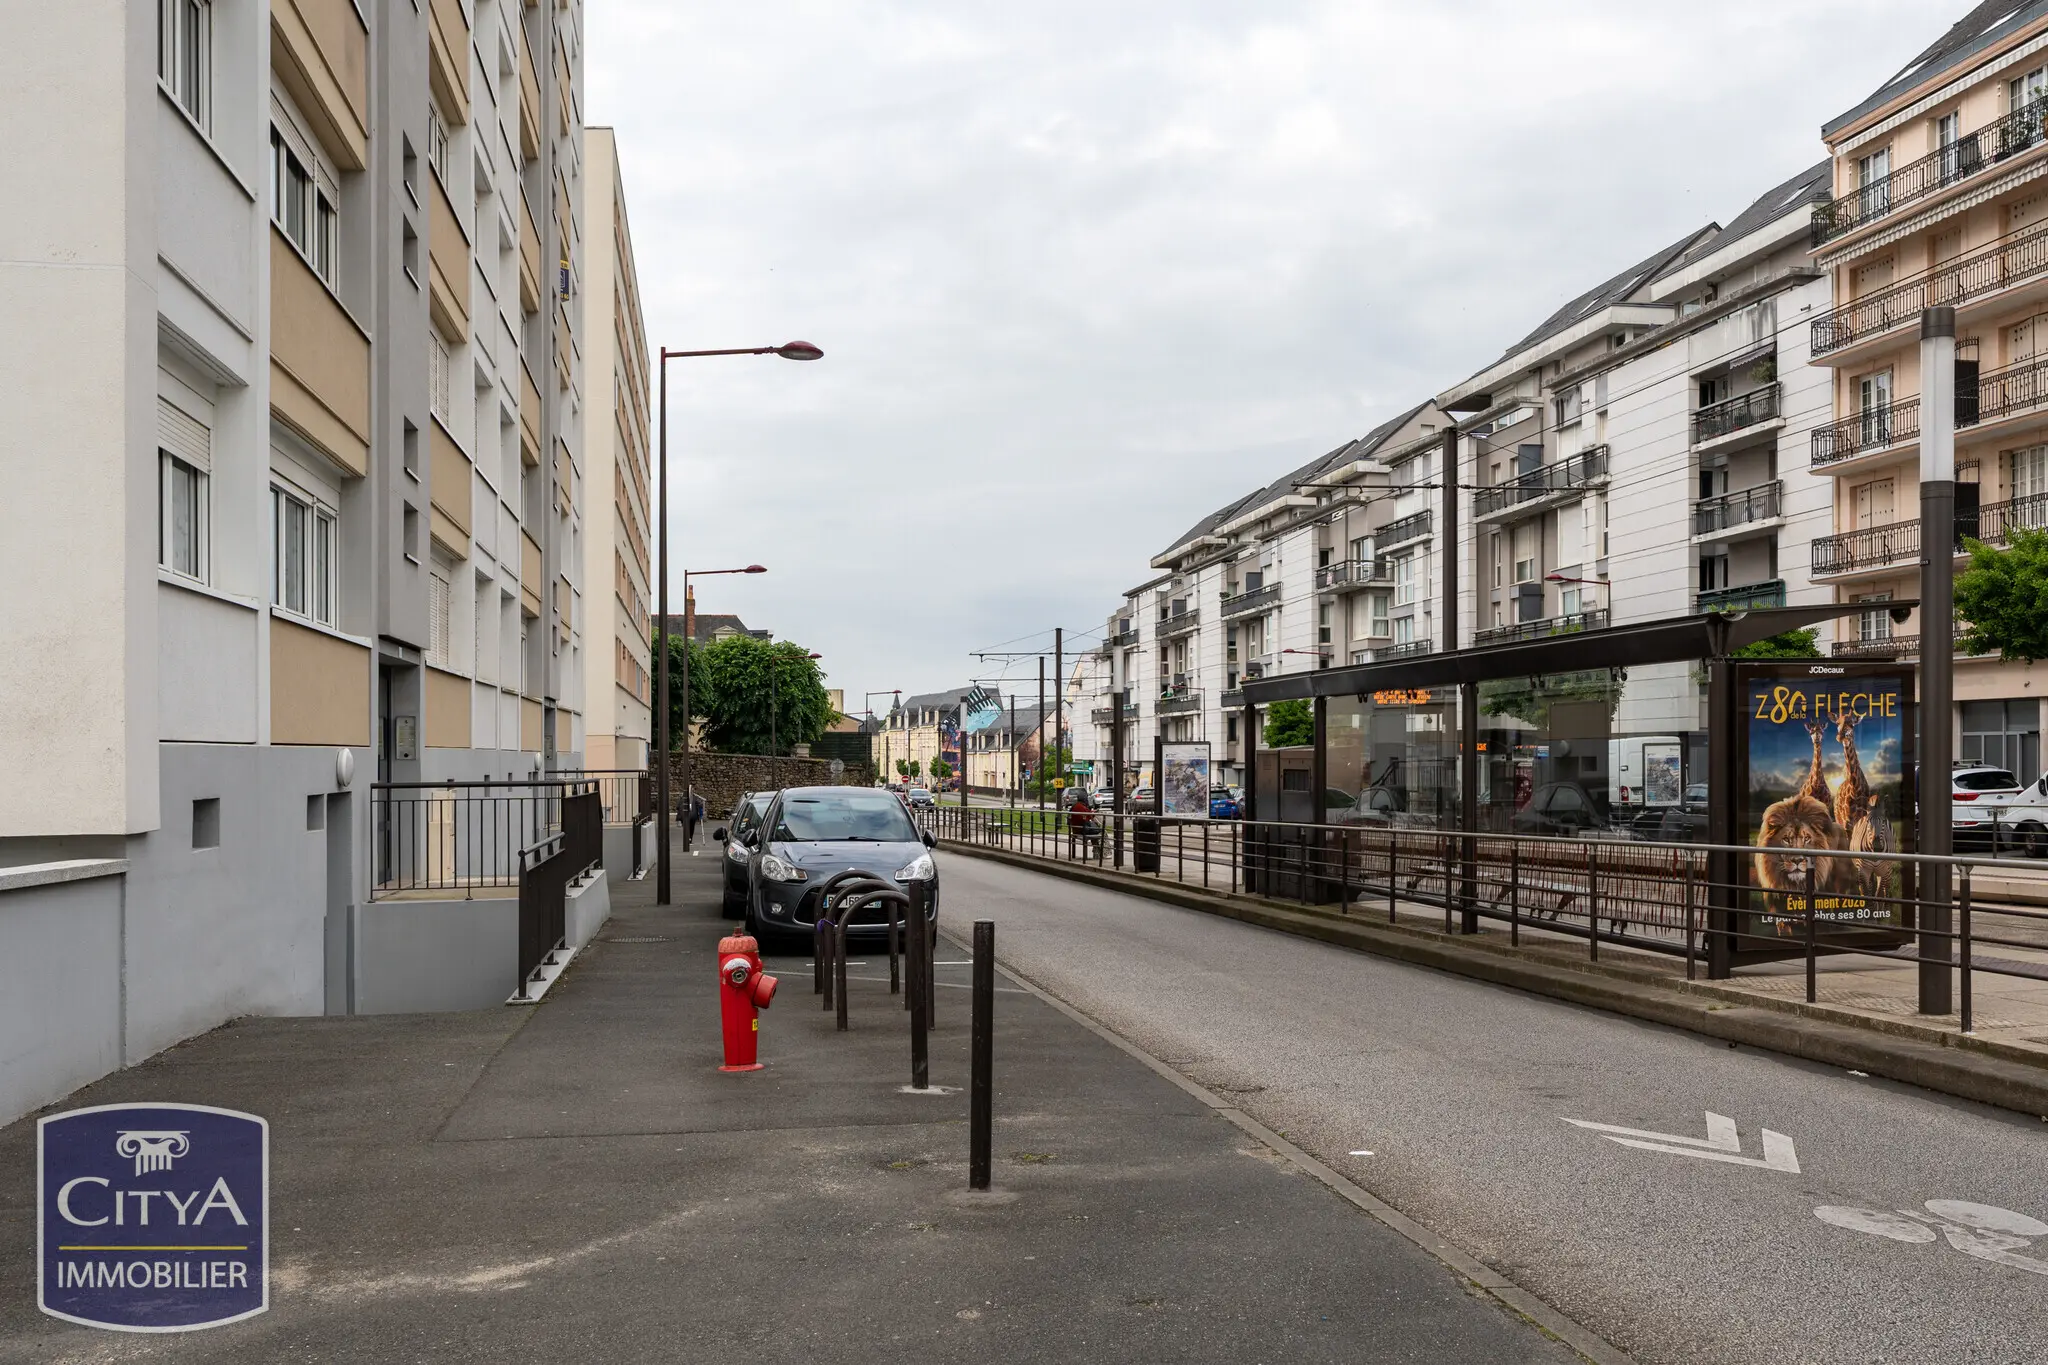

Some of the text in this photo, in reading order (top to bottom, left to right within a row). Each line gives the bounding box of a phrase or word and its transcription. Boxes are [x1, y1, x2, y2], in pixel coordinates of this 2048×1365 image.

[1808, 666, 1845, 674] JCDecaux
[1787, 895, 1840, 911] Évèment
[1837, 911, 1855, 920] ses
[1856, 908, 1871, 919] 80
[1872, 910, 1891, 918] ans
